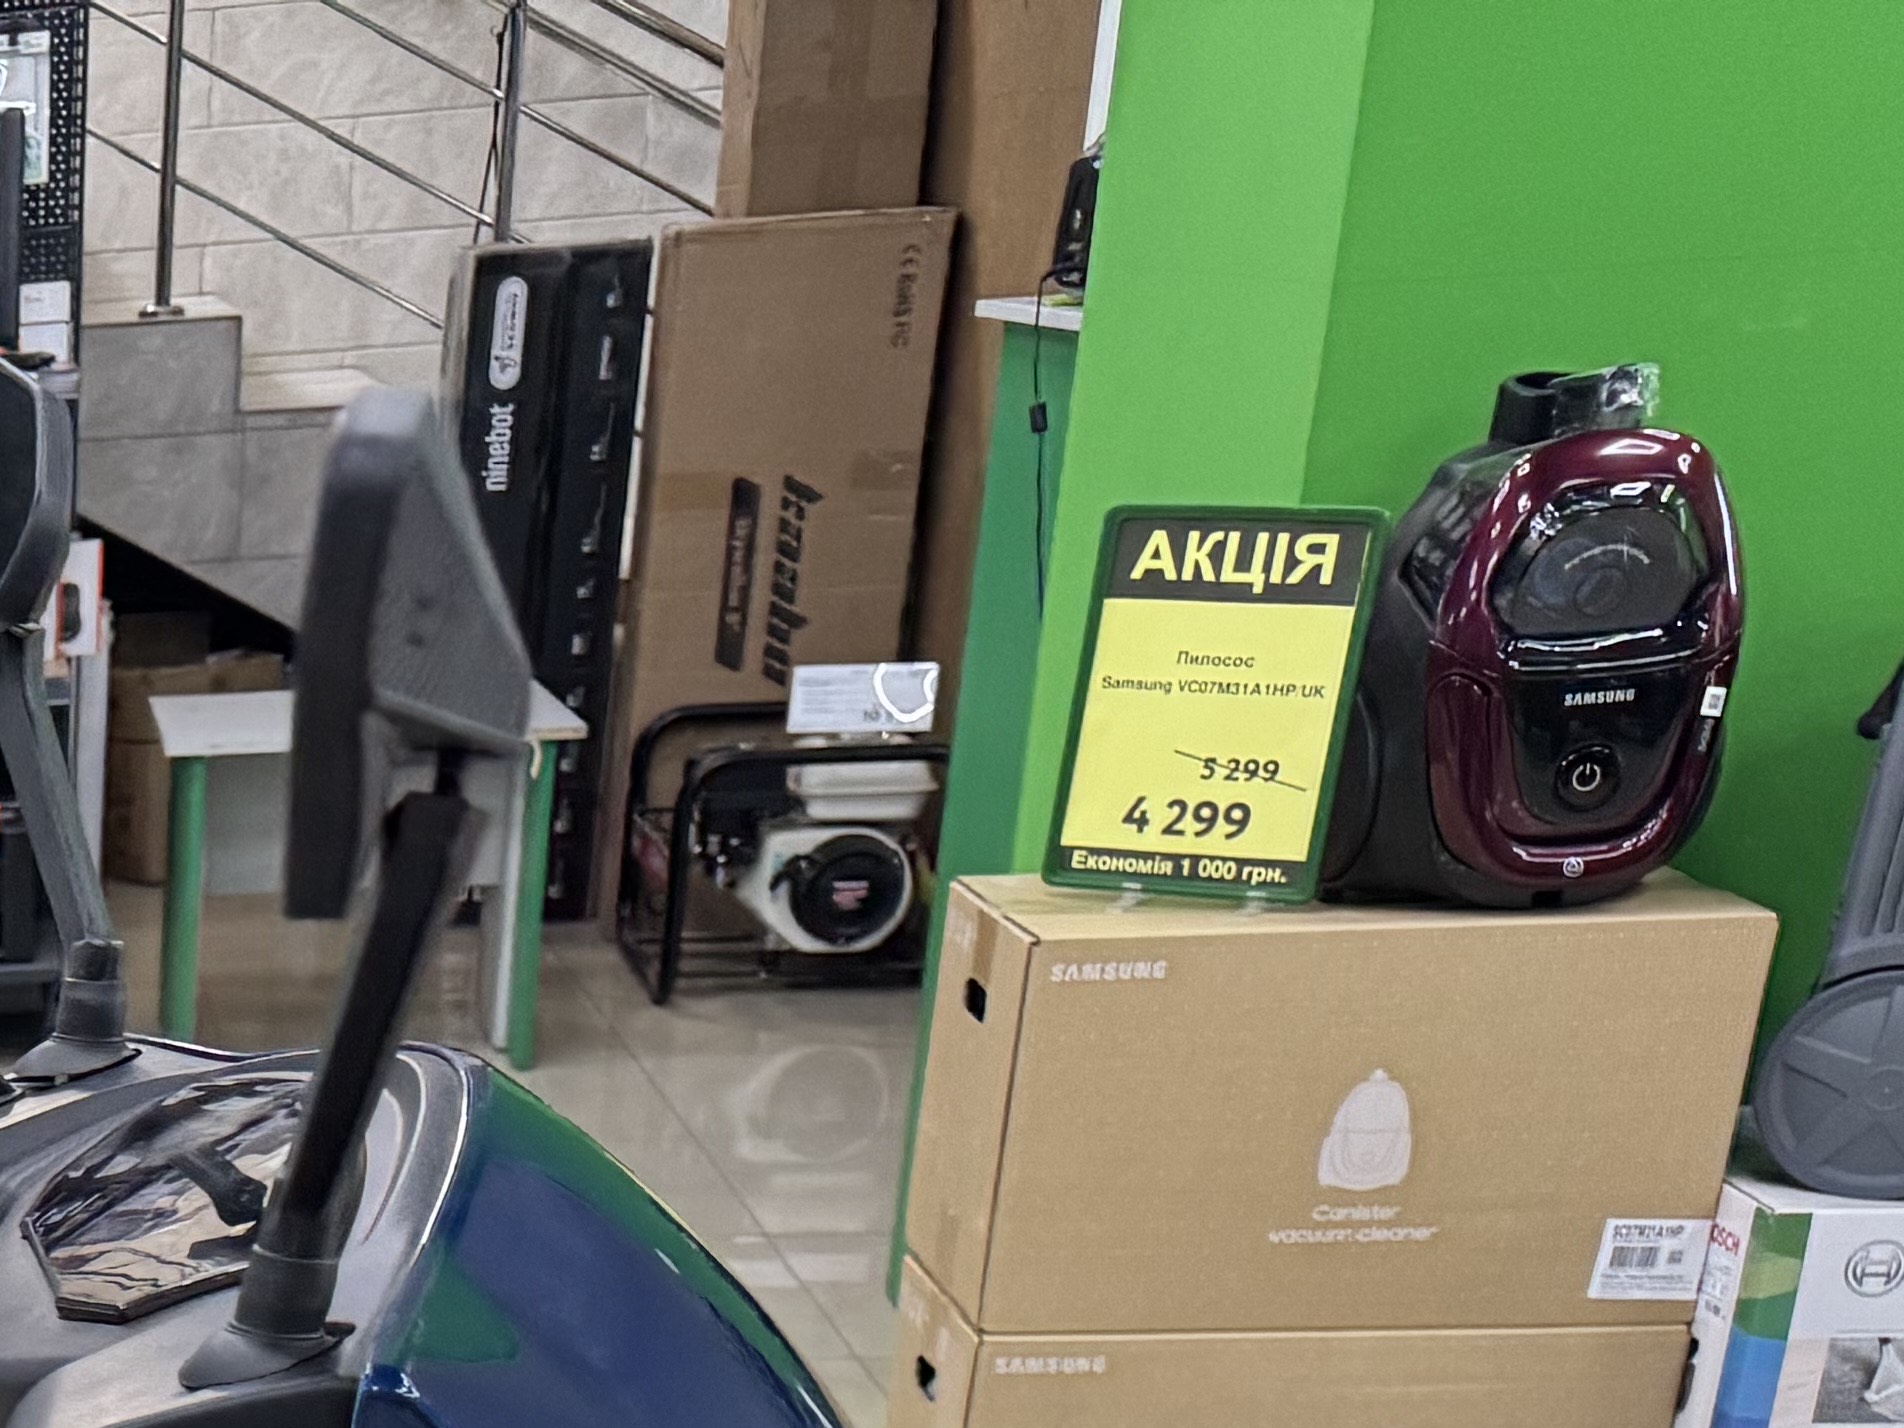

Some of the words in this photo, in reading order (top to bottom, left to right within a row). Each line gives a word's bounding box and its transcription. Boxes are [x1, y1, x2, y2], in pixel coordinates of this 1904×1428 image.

[482, 401, 515, 491] ninebot
[1130, 529, 1340, 594] АКЦІЯ
[1176, 650, 1256, 668] Пилосос
[1101, 675, 1173, 695] Samsung
[1563, 688, 1636, 707] SAMSUNG
[1200, 757, 1217, 781] 5
[1223, 758, 1280, 783] 299
[1121, 795, 1150, 833] 4
[1160, 798, 1252, 840] 299
[1071, 850, 1174, 876] Економія
[1180, 858, 1191, 876] 1
[1197, 859, 1237, 881] 000
[1241, 865, 1287, 886] грн.
[1050, 959, 1168, 983] SAMSUNG
[1710, 1222, 1741, 1257] OSCH
[995, 1355, 1105, 1375] SAMSUNG
